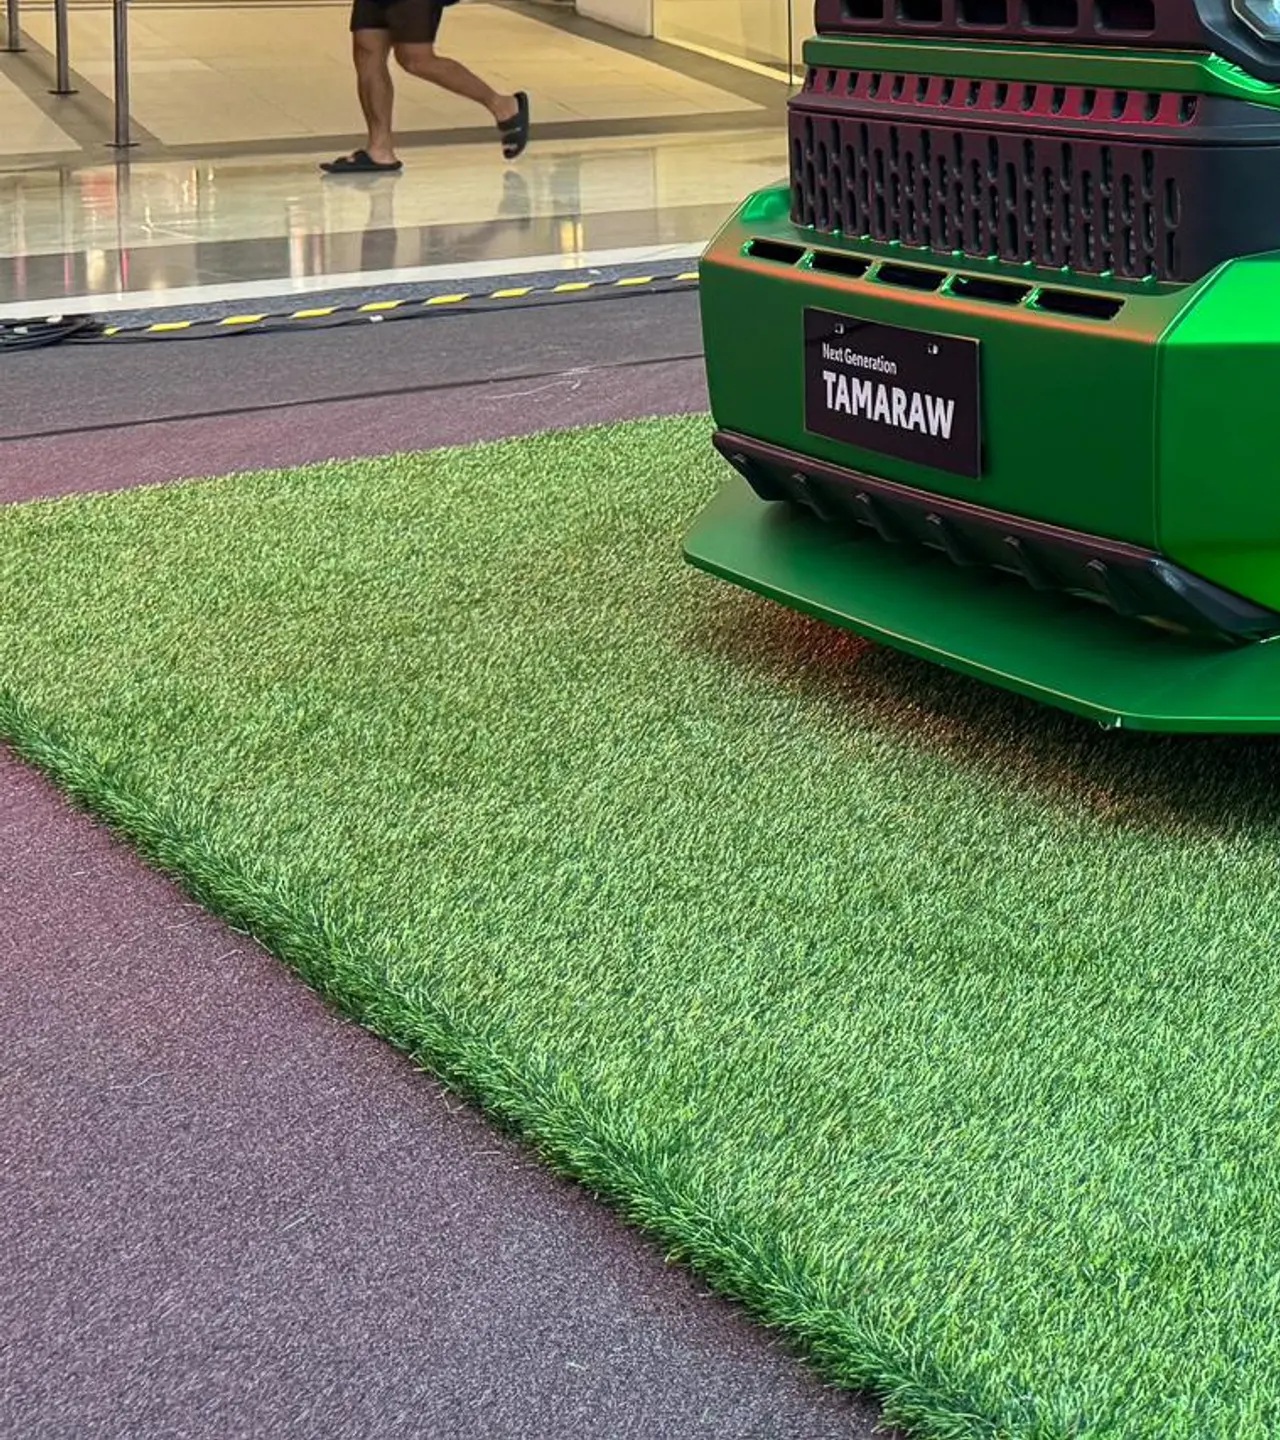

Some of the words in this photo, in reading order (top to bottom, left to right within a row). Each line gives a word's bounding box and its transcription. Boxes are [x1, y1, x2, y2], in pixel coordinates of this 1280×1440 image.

[822, 342, 843, 363] Next
[843, 347, 898, 375] Generation
[822, 370, 955, 440] TAMARAW
